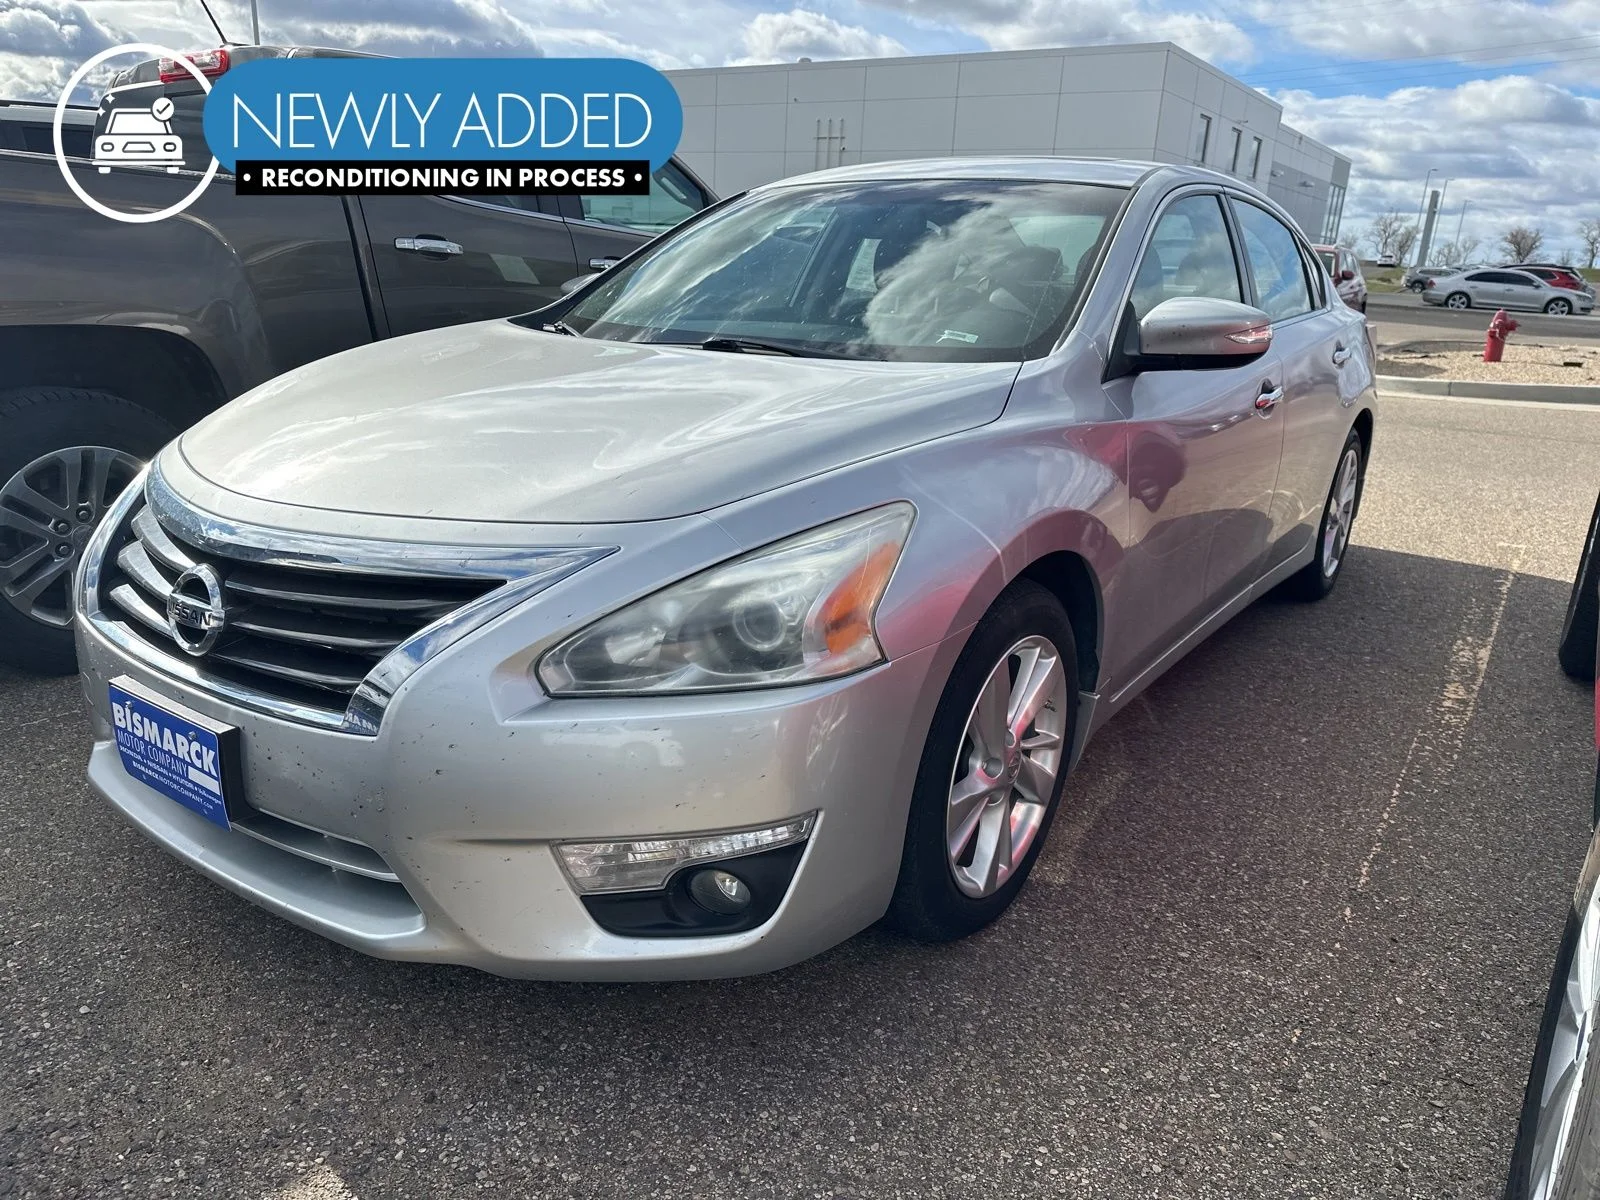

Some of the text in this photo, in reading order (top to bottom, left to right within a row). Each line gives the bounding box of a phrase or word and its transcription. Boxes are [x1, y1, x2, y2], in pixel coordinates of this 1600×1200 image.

[112, 702, 218, 778] BISMARCK
[117, 729, 188, 778] MOTOR COMPANY
